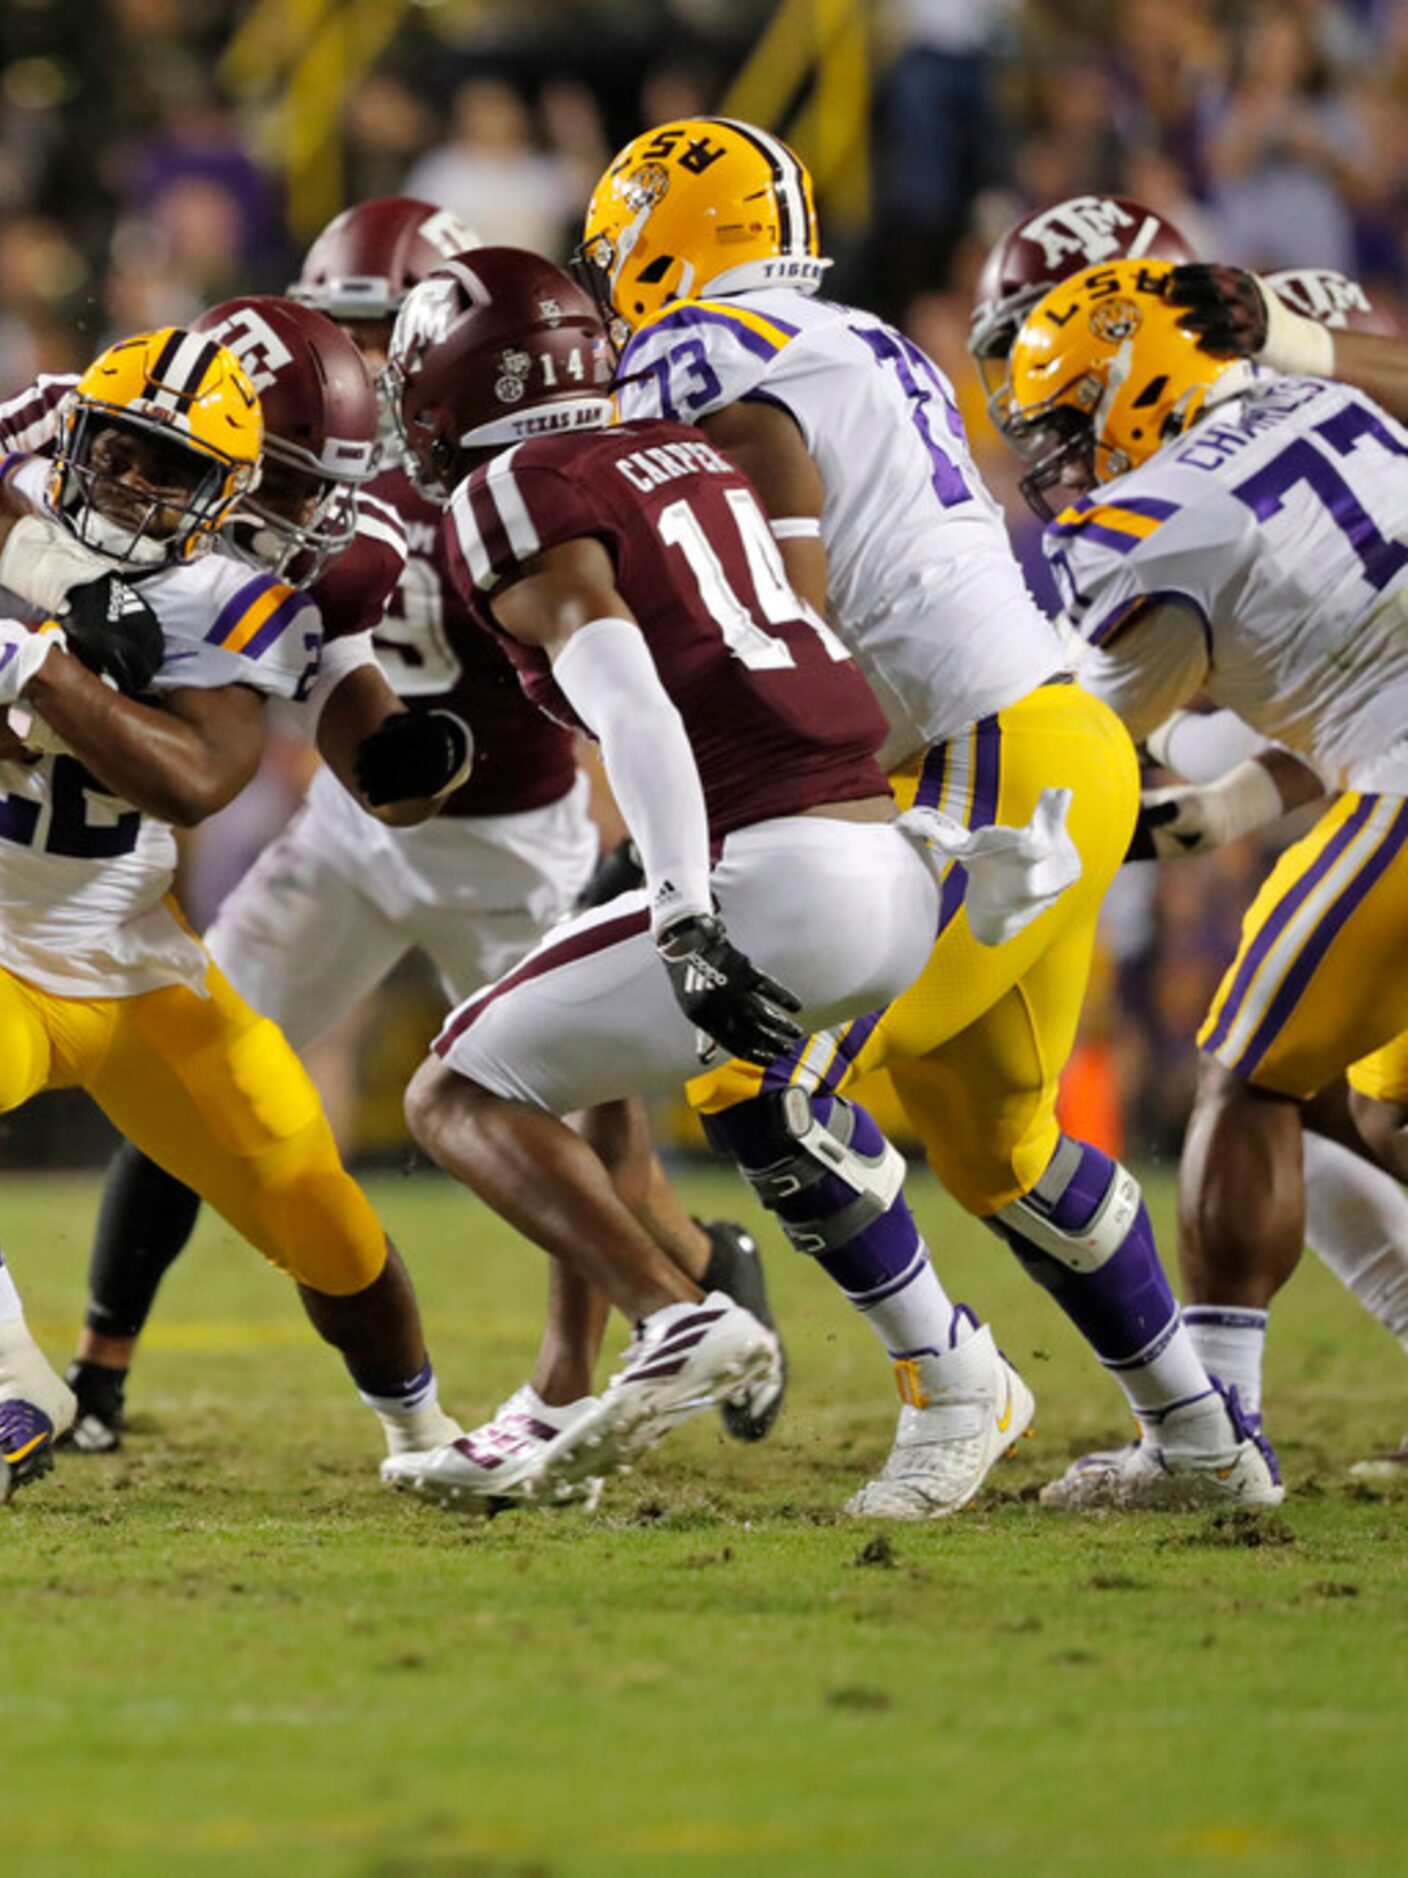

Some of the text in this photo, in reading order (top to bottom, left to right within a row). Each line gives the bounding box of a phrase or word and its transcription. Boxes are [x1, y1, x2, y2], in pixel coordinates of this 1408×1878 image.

[540, 347, 585, 387] 14
[635, 338, 723, 423] 73
[511, 411, 570, 436] TEXAS
[656, 487, 854, 672] 14
